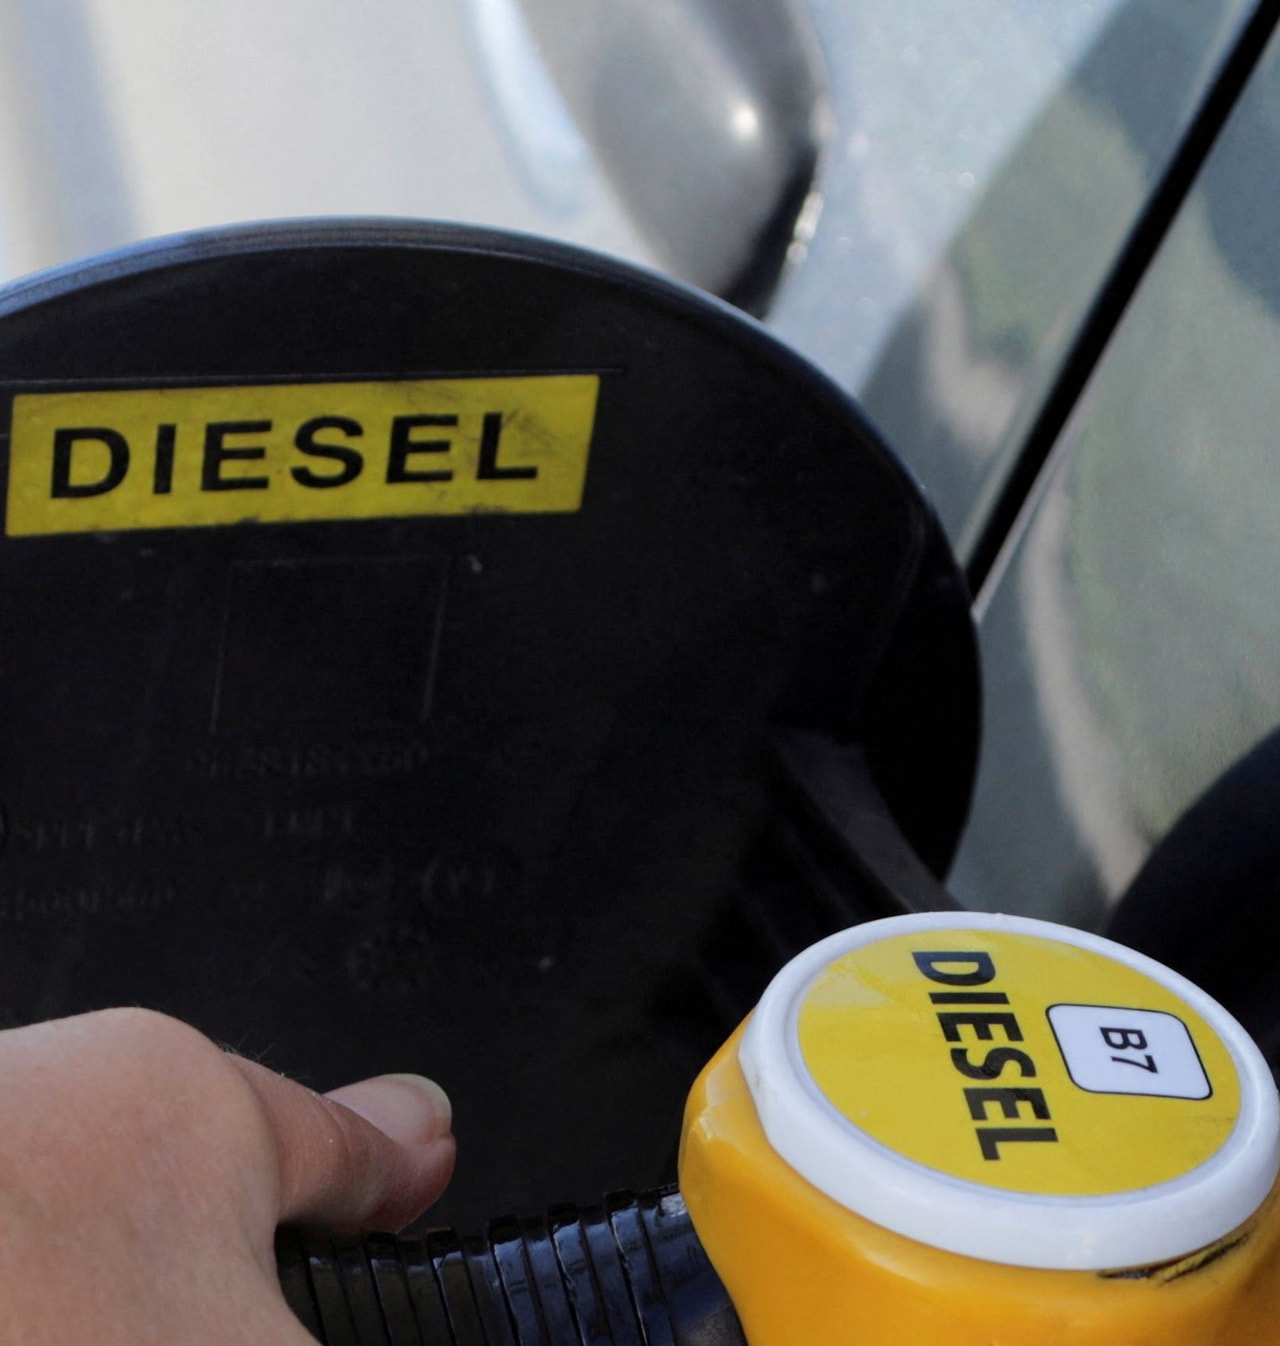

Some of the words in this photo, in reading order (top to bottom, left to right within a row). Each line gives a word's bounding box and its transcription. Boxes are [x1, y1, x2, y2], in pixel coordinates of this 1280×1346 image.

[49, 411, 539, 500] DIESEL
[911, 950, 1059, 1162] DIESEL
[1098, 1026, 1159, 1074] B7
